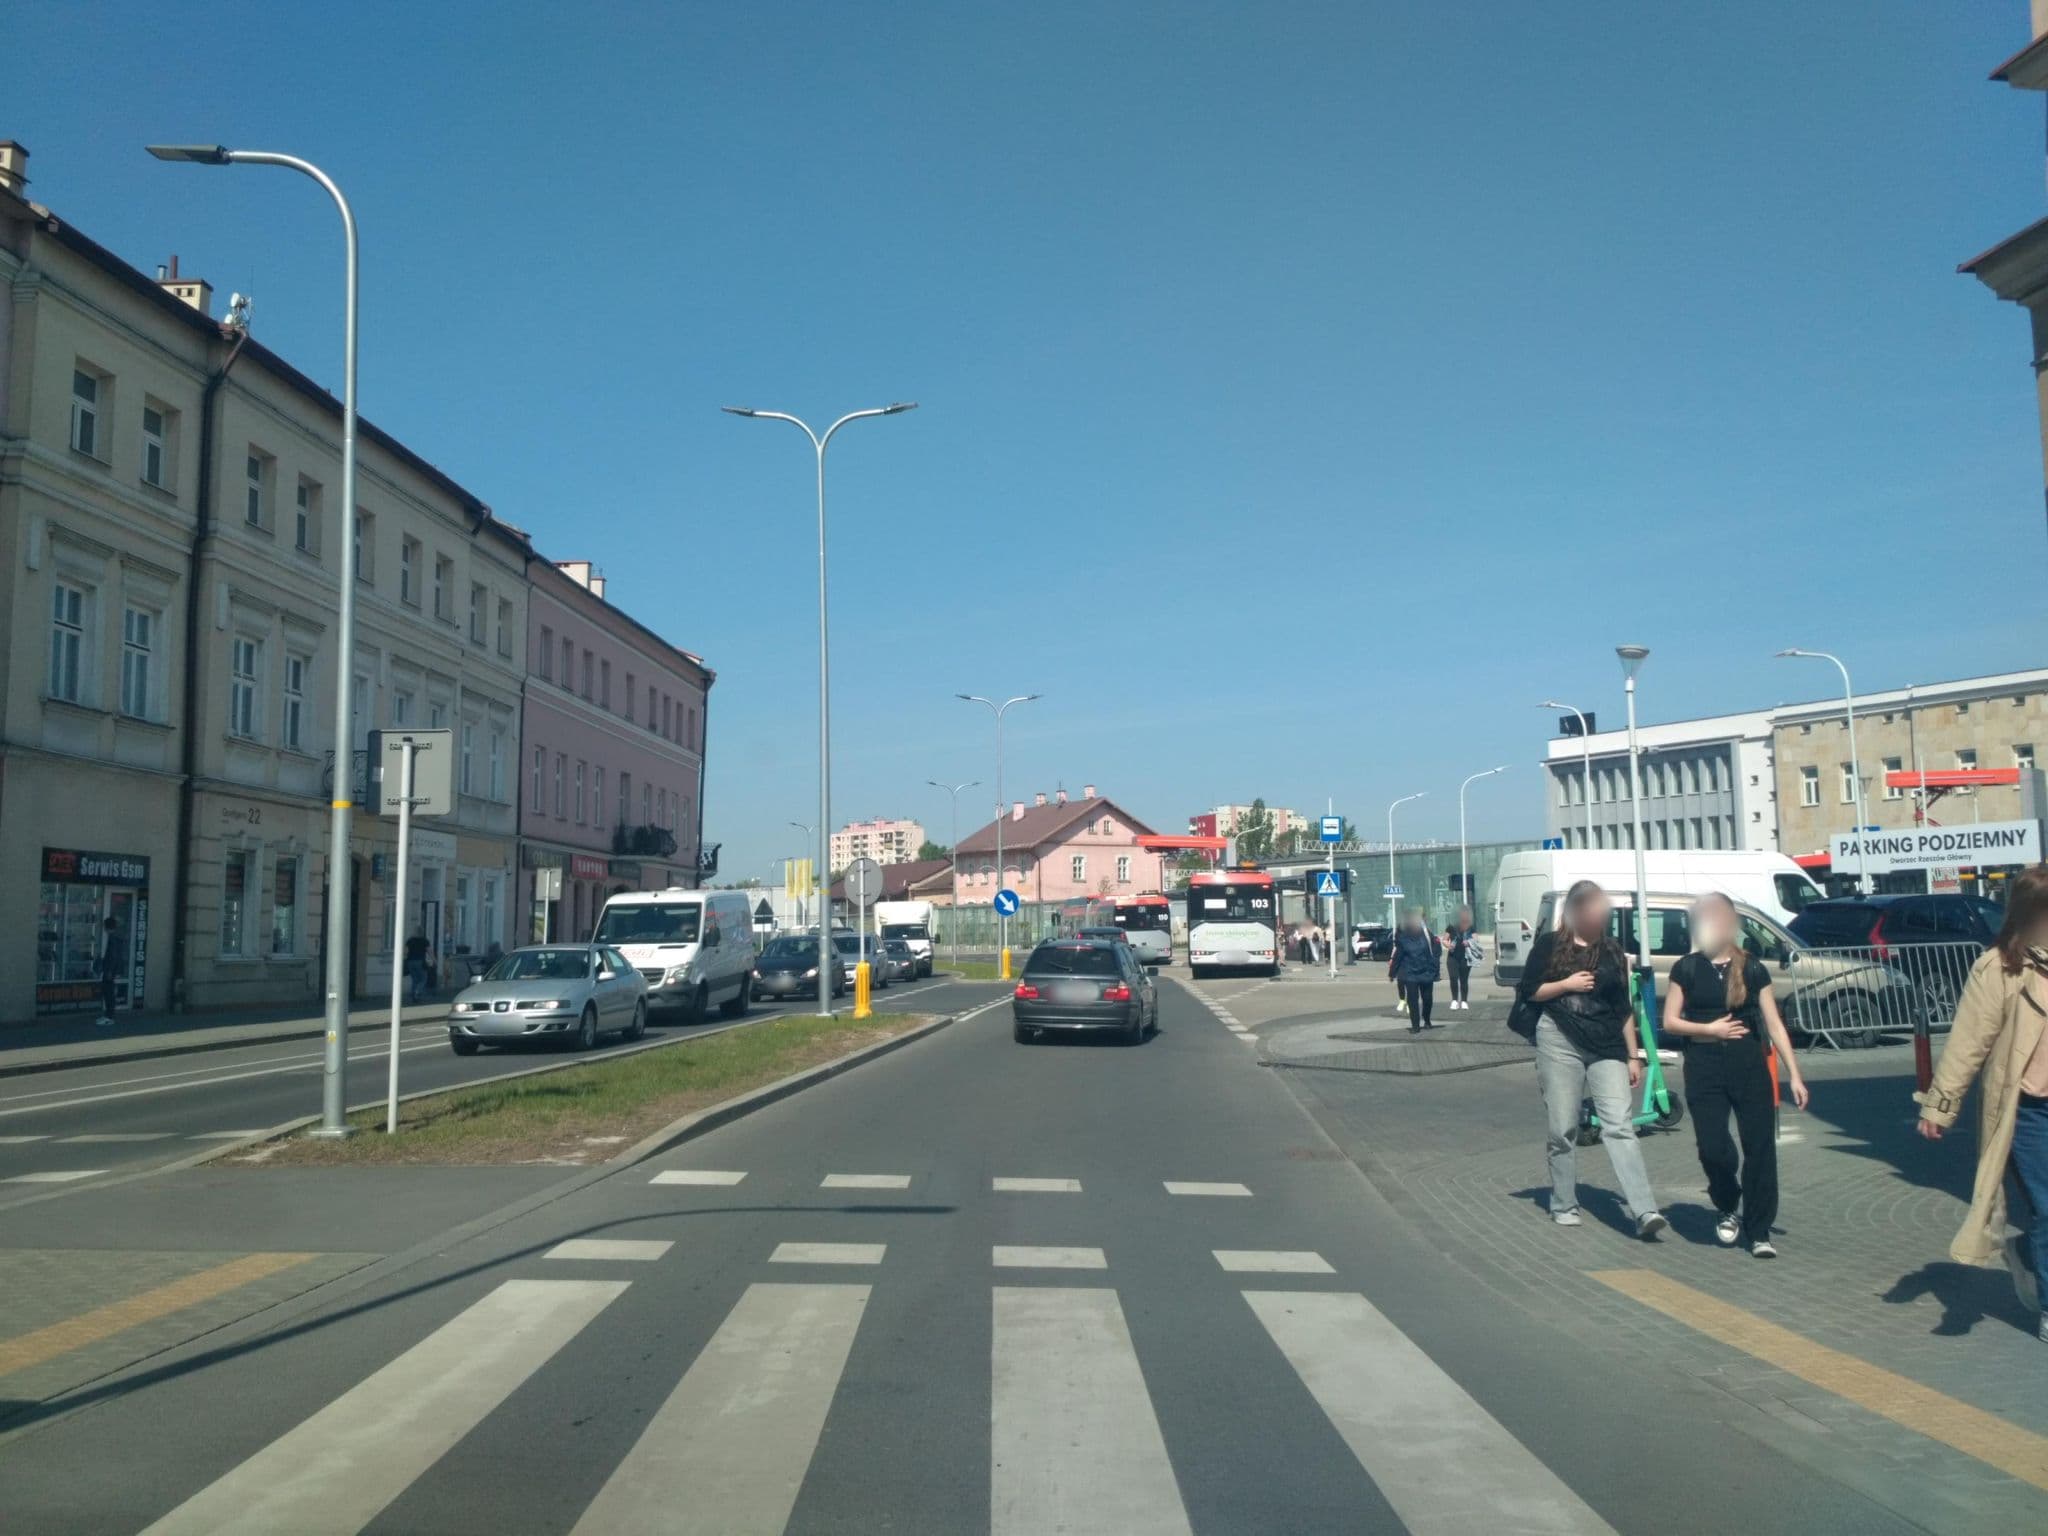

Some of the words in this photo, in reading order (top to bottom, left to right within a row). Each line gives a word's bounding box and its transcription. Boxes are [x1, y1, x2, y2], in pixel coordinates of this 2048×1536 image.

[248, 807, 261, 825] 22
[1840, 837, 1913, 857] PARKING
[1918, 828, 2027, 851] PODZIEMNY
[80, 857, 119, 877] Serwis
[121, 860, 144, 879] Gsm
[1890, 856, 1916, 865] Dworzec
[1918, 855, 1945, 863] Rzeszów
[1946, 852, 1972, 862] Główny
[1251, 898, 1269, 909] 103
[136, 899, 147, 962] SERWIS
